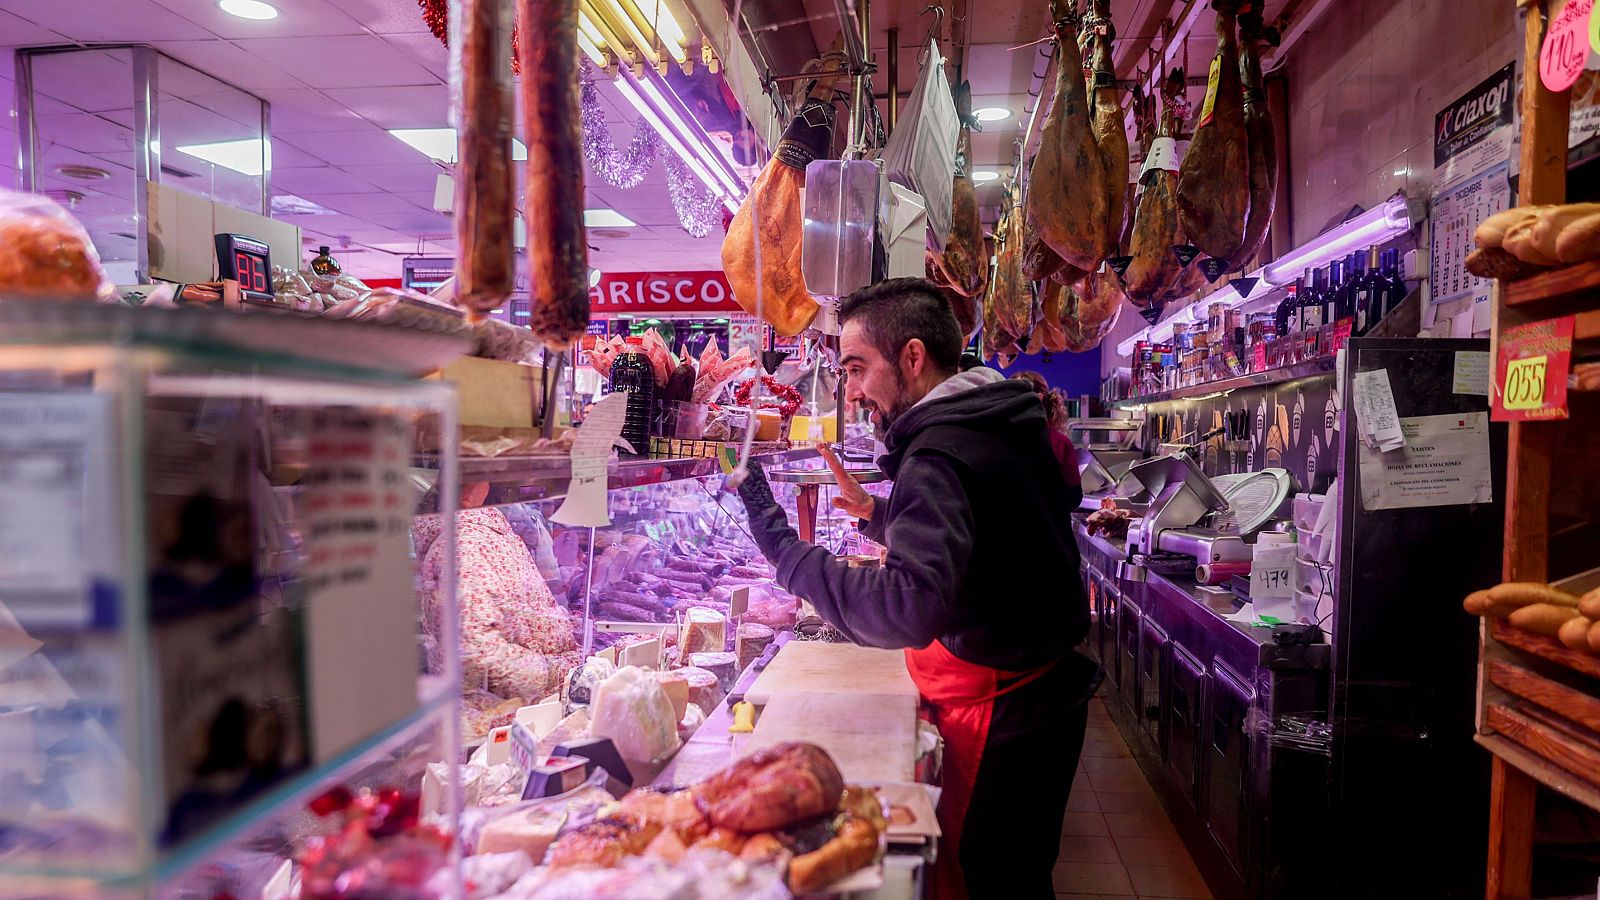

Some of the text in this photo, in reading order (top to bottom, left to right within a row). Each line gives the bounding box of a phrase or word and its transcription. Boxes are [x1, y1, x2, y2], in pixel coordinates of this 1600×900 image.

[1454, 79, 1509, 132] Claxon
[1455, 180, 1482, 201] DICIEMBRE
[589, 279, 736, 305] ARISCO
[1414, 461, 1462, 469] RECLAMACIONES
[1259, 569, 1289, 589] 479
